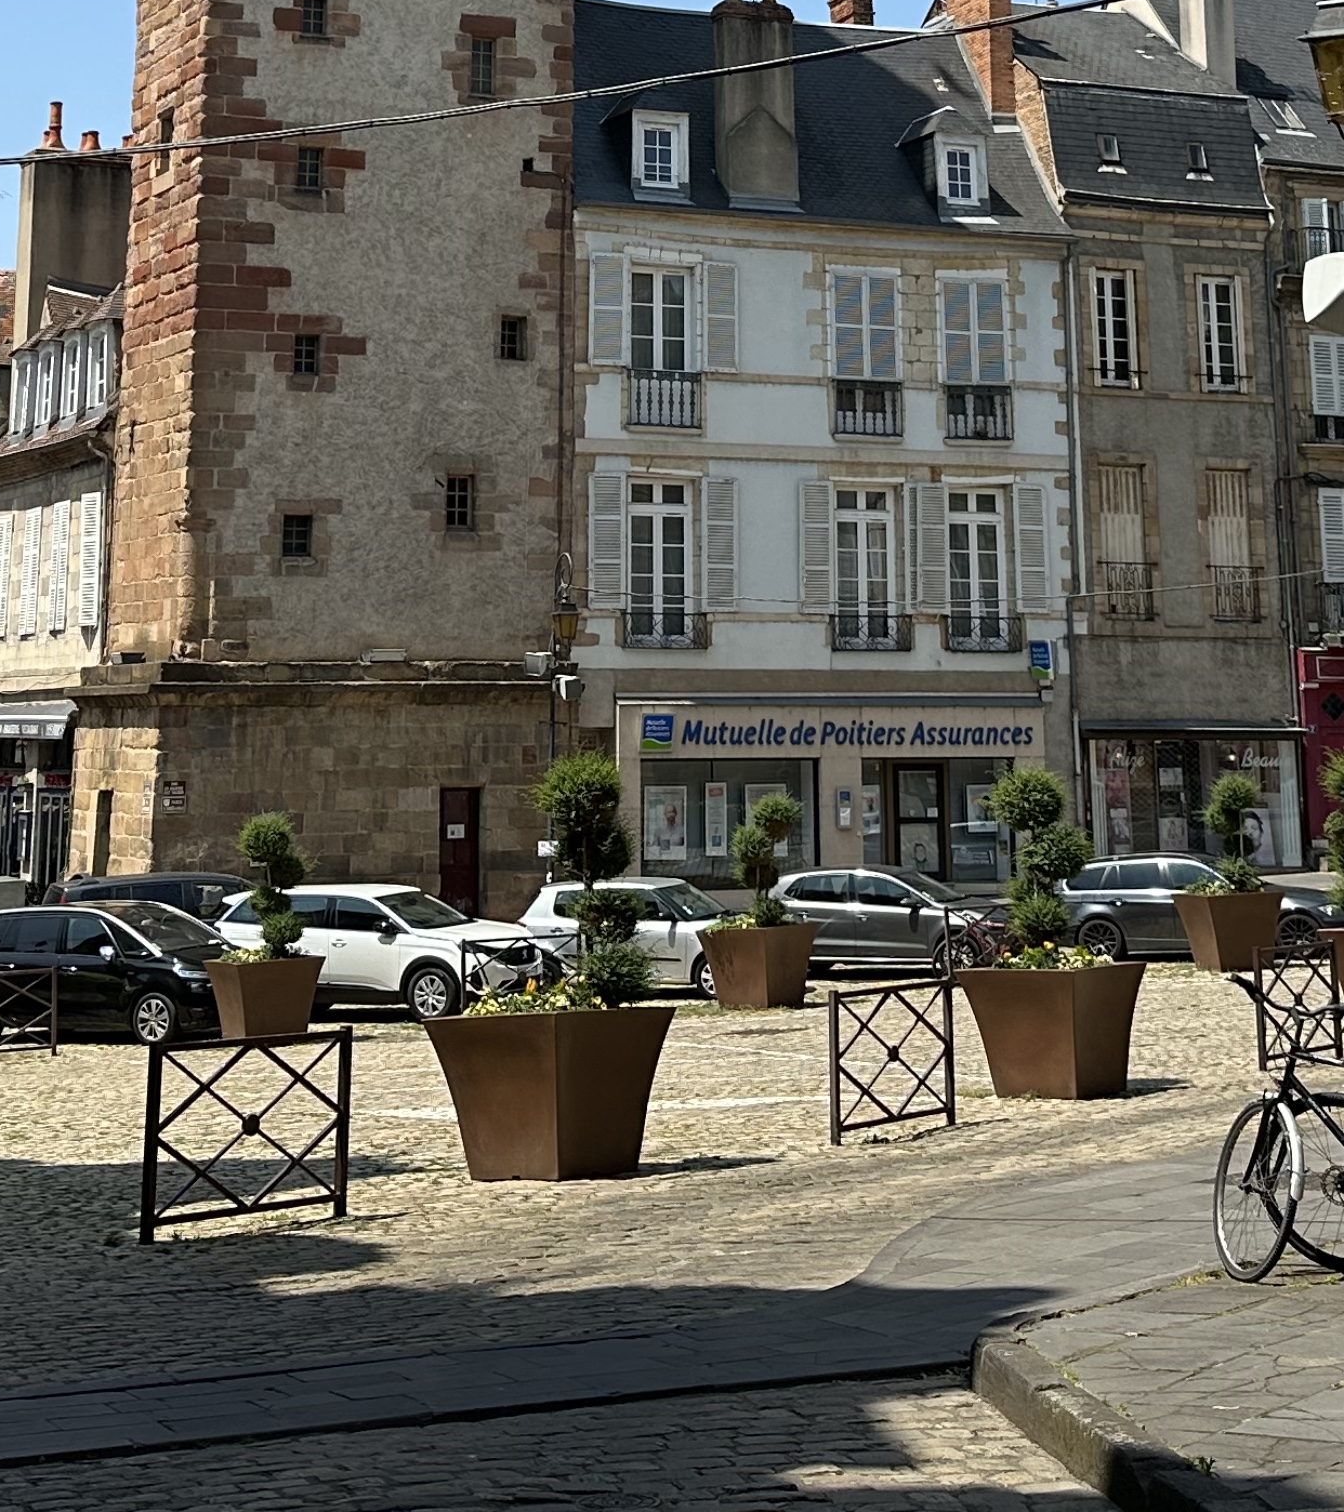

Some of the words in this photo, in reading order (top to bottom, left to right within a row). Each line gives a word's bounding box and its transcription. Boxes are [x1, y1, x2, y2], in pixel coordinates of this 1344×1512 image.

[681, 719, 785, 745] Mutuelle
[789, 720, 816, 745] de
[820, 720, 906, 746] Poitiers
[909, 721, 1034, 746] Assurances
